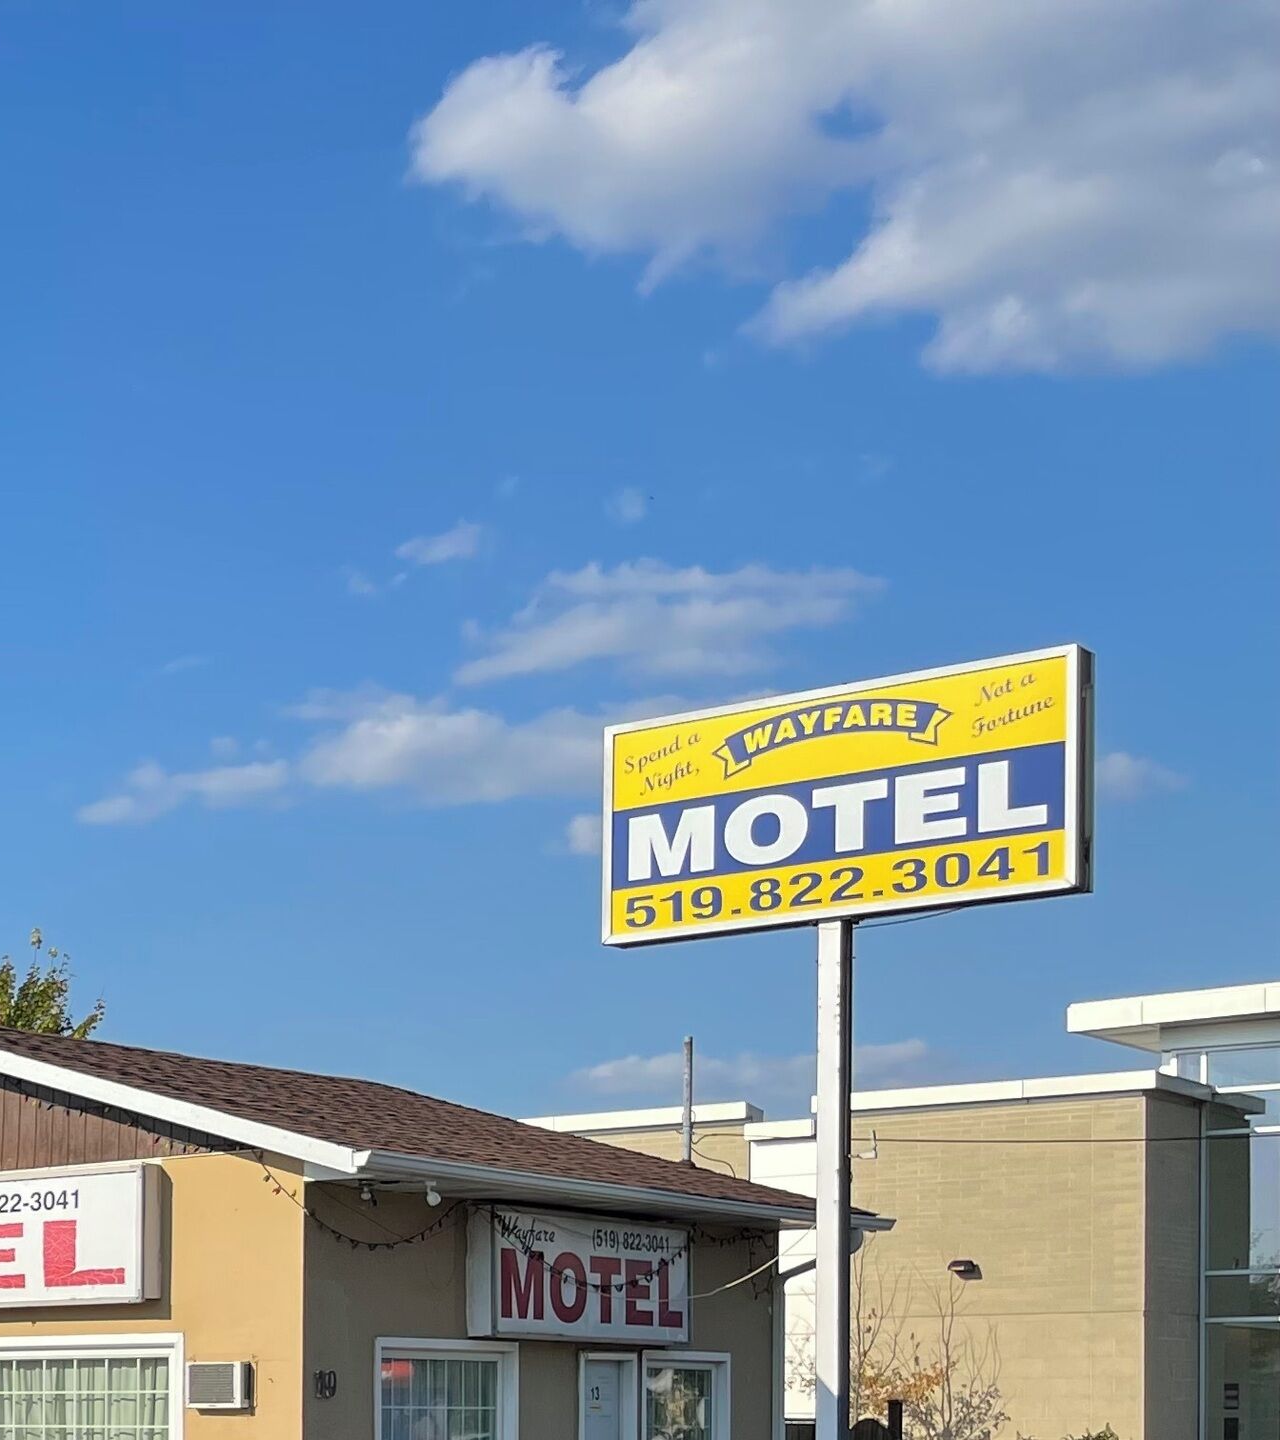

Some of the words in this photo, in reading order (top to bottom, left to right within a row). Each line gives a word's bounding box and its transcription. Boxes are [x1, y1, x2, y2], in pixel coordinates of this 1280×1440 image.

[974, 678, 1014, 707] Not
[1020, 673, 1037, 688] a
[743, 703, 917, 754] WAYFARE
[971, 696, 1056, 738] Fortune
[624, 734, 681, 774] Spend
[687, 733, 701, 746] a
[640, 760, 700, 796] Night,
[628, 759, 1049, 883] MOTEL
[625, 841, 1052, 928] 519.822.3041
[500, 1215, 556, 1253] Wayfare
[592, 1227, 620, 1253] (519)
[622, 1230, 671, 1253] 822-3041
[500, 1247, 683, 1328] MOTEL
[590, 1386, 600, 1401] 13
